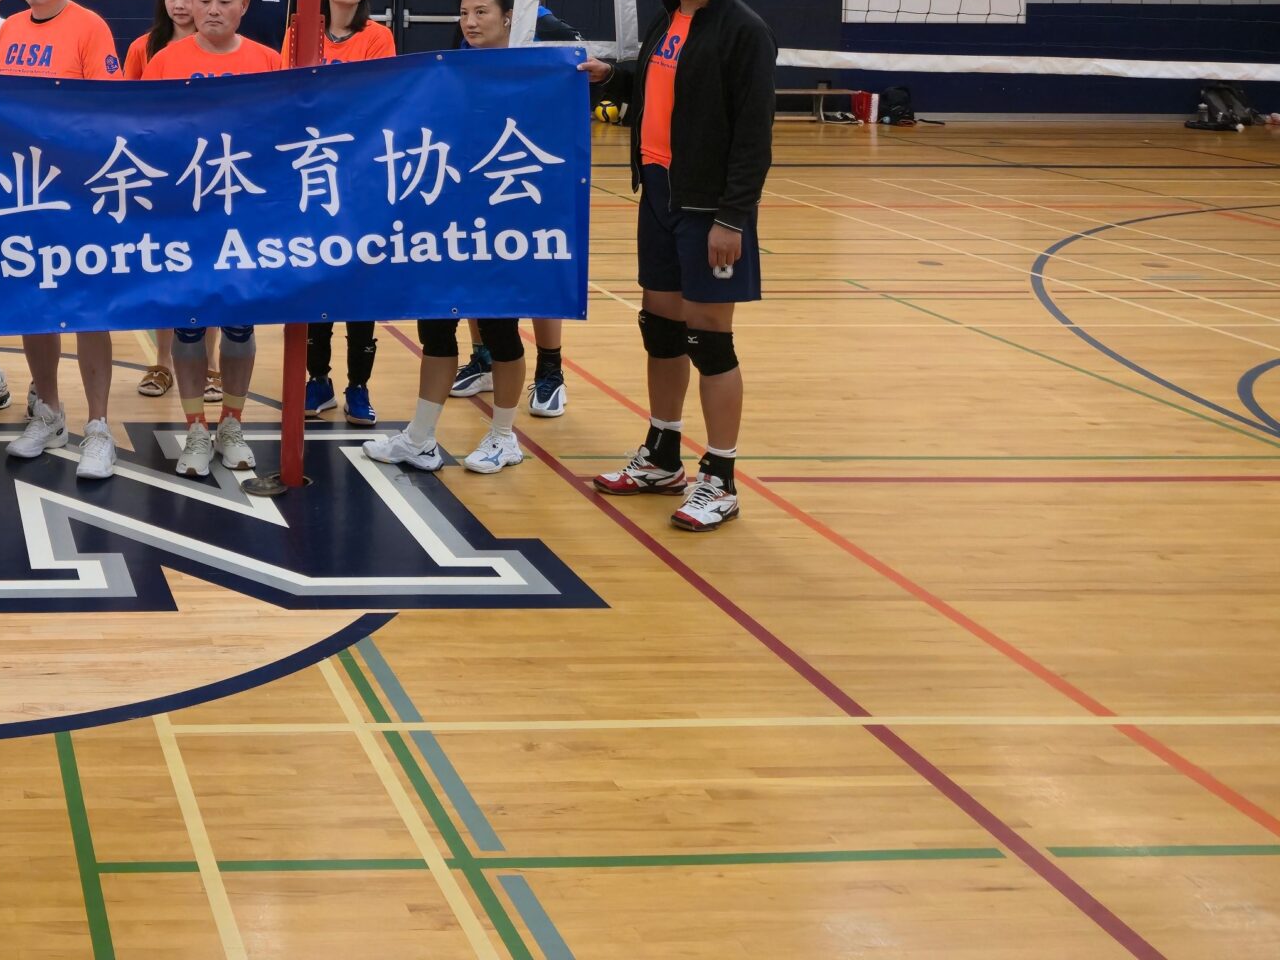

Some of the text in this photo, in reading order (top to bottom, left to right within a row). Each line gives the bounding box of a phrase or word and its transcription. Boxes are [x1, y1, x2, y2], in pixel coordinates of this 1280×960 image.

[5, 43, 53, 67] CLSA
[0, 232, 193, 289] Sports
[213, 216, 572, 271] Association
